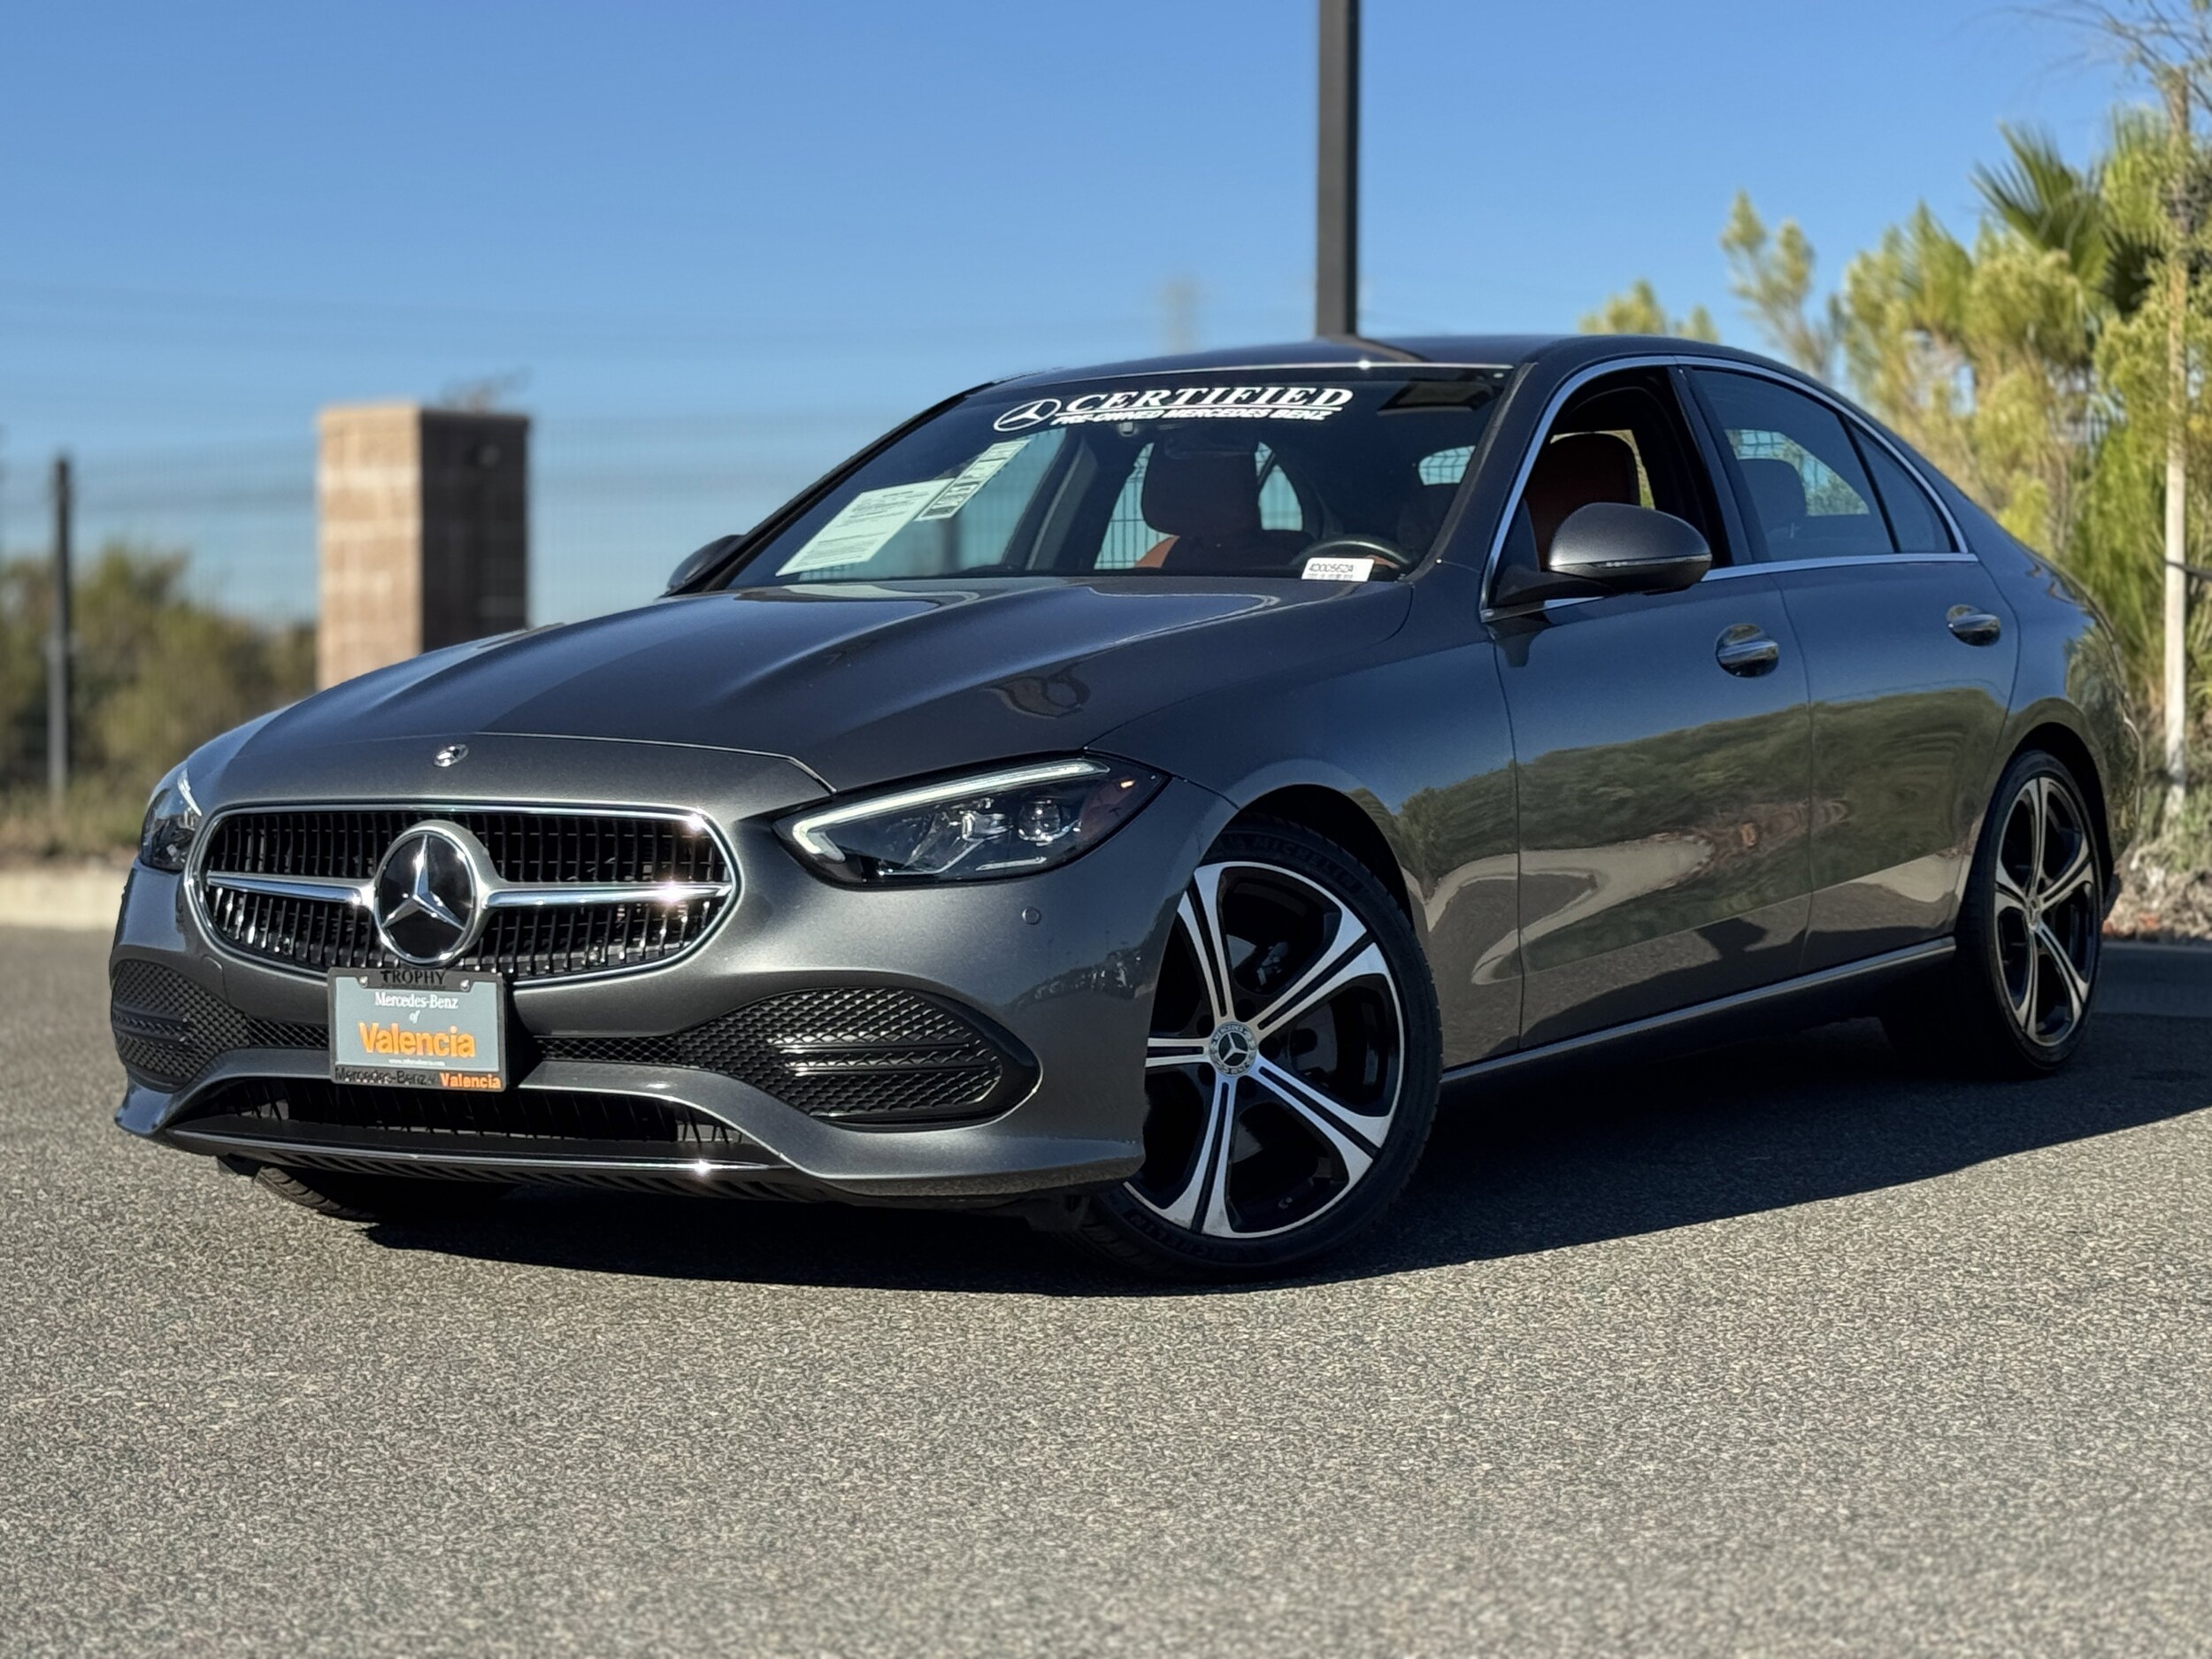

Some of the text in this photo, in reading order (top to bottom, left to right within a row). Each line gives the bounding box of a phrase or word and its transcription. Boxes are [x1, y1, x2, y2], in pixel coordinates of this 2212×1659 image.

[1065, 387, 1354, 413] CERTIFIED
[1051, 408, 1333, 426] PRE-OWNED MERCEDES BENZ
[380, 970, 446, 985] TROPHY
[375, 992, 458, 1009] Mercedes-Benz
[409, 1010, 420, 1024] of
[358, 1021, 476, 1057] Valencia
[334, 1068, 427, 1085] Mercedes-Benz
[440, 1072, 502, 1089] Valencia
